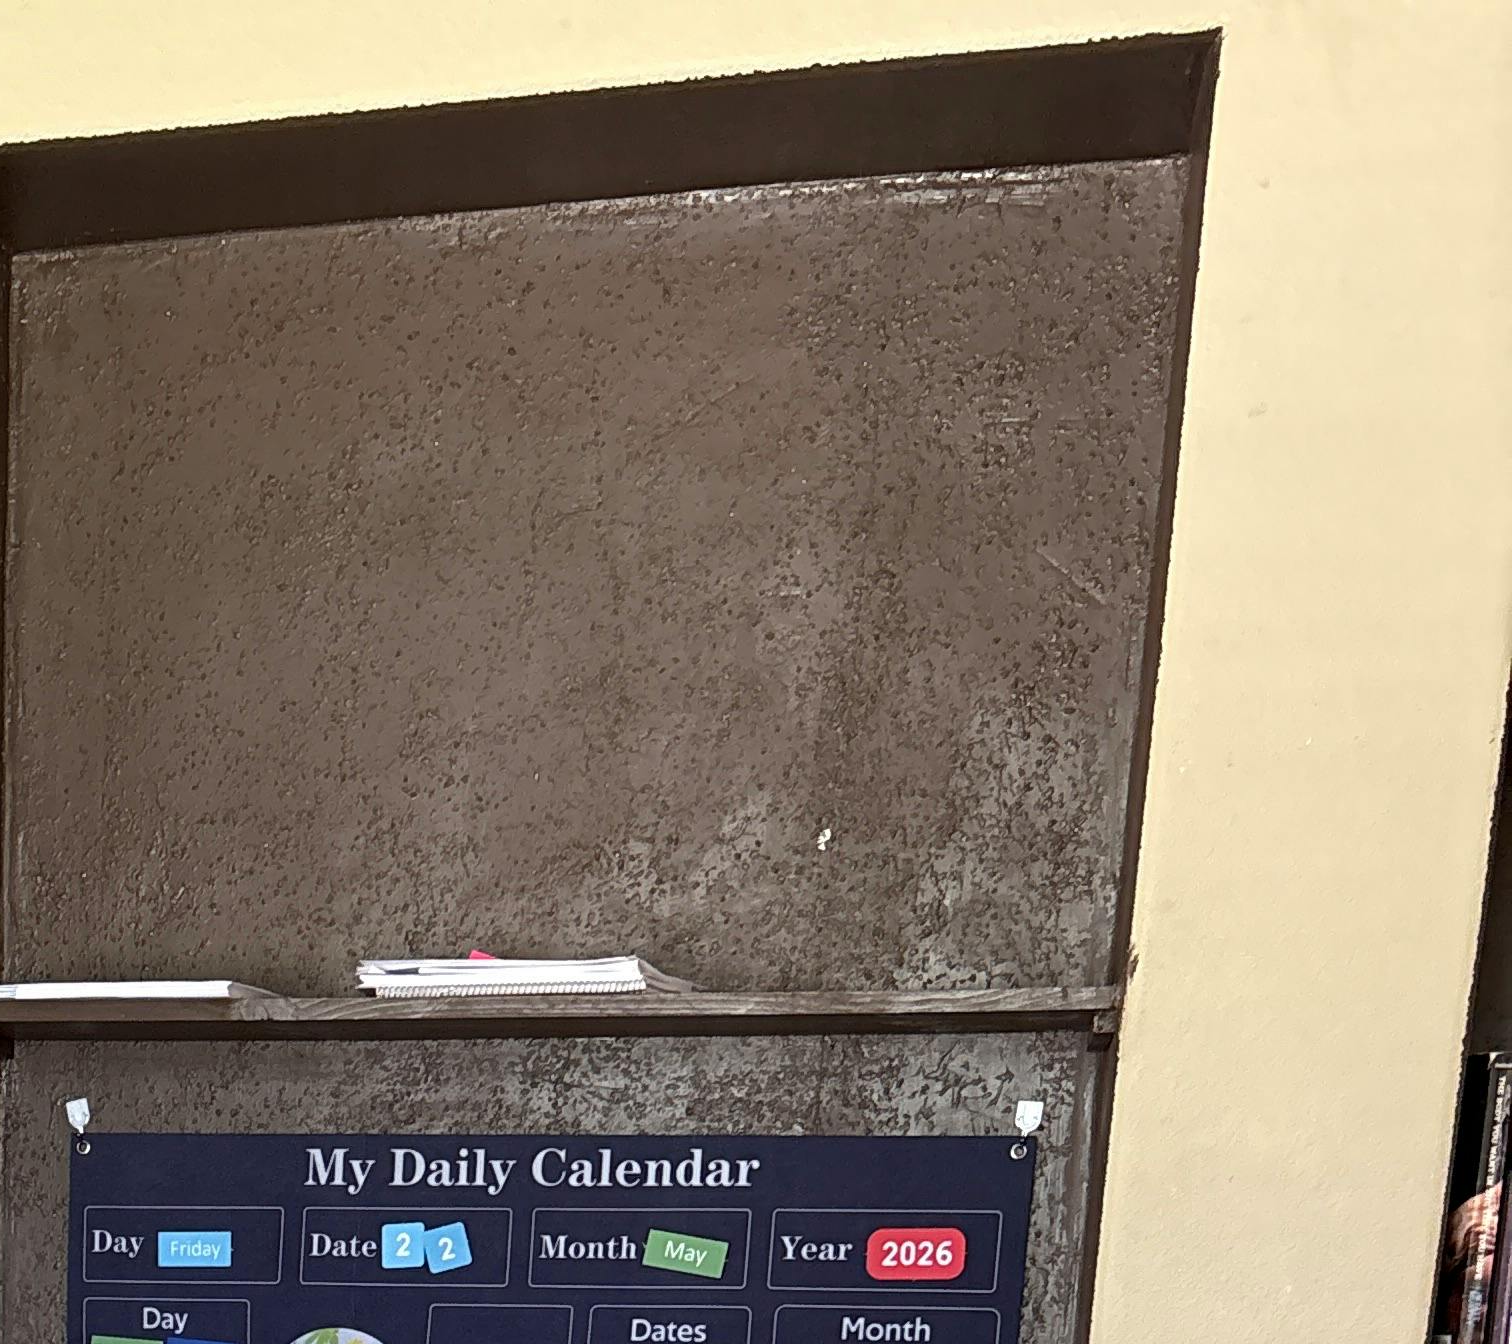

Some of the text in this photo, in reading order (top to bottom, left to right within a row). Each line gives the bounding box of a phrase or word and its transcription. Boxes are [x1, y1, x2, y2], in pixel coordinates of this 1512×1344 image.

[1496, 1075, 1506, 1094] THE
[1492, 1097, 1503, 1121] BODY
[1490, 1123, 1500, 1142] YOU
[304, 1147, 761, 1195] My Daily Calendar
[1486, 1145, 1497, 1173] WANT
[92, 1229, 221, 1260] Day Friday
[309, 1233, 456, 1261] Date 2 2
[538, 1234, 708, 1268] Month May
[780, 1235, 953, 1267] Year 2026
[142, 1307, 189, 1334] Day
[630, 1319, 707, 1343] Dates
[840, 1316, 931, 1342] Month
